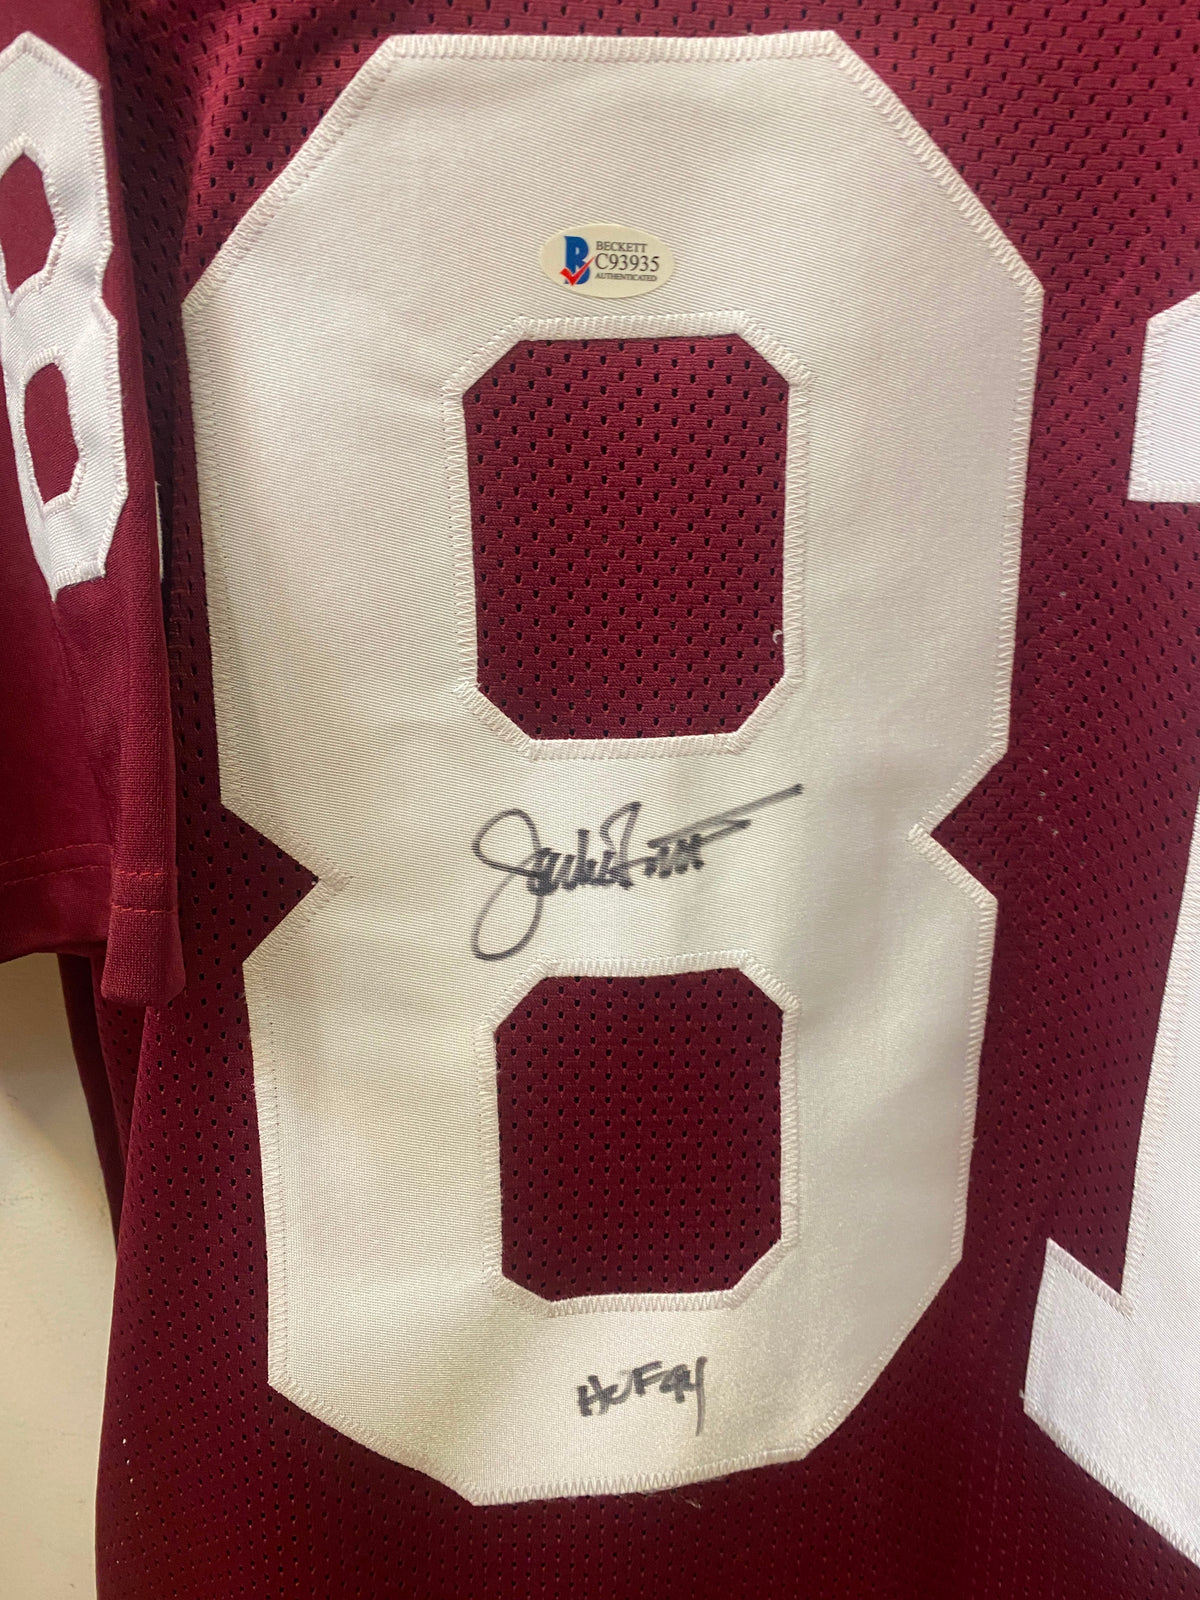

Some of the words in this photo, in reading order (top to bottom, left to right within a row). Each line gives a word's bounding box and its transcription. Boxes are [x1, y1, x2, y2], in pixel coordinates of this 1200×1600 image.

[595, 240, 648, 253] BECKETT
[595, 252, 660, 272] C93935
[595, 272, 658, 282] AUTHENTICATED
